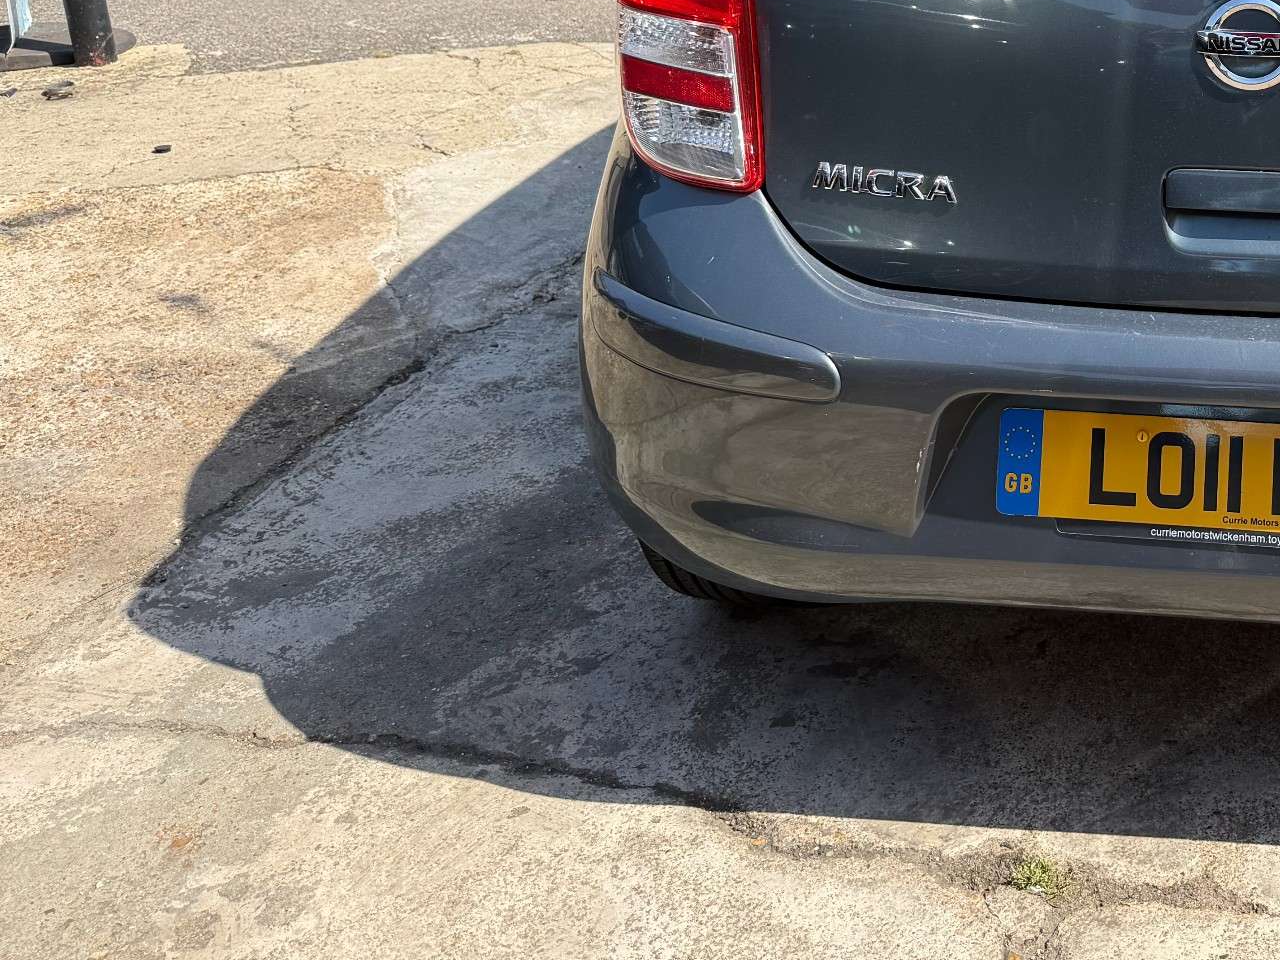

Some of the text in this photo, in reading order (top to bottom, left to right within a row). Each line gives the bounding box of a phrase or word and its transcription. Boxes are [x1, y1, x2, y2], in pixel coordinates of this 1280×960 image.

[812, 161, 958, 204] MICRA
[1003, 471, 1034, 495] GB
[1222, 516, 1248, 525] Currie
[1250, 517, 1279, 527] Motors
